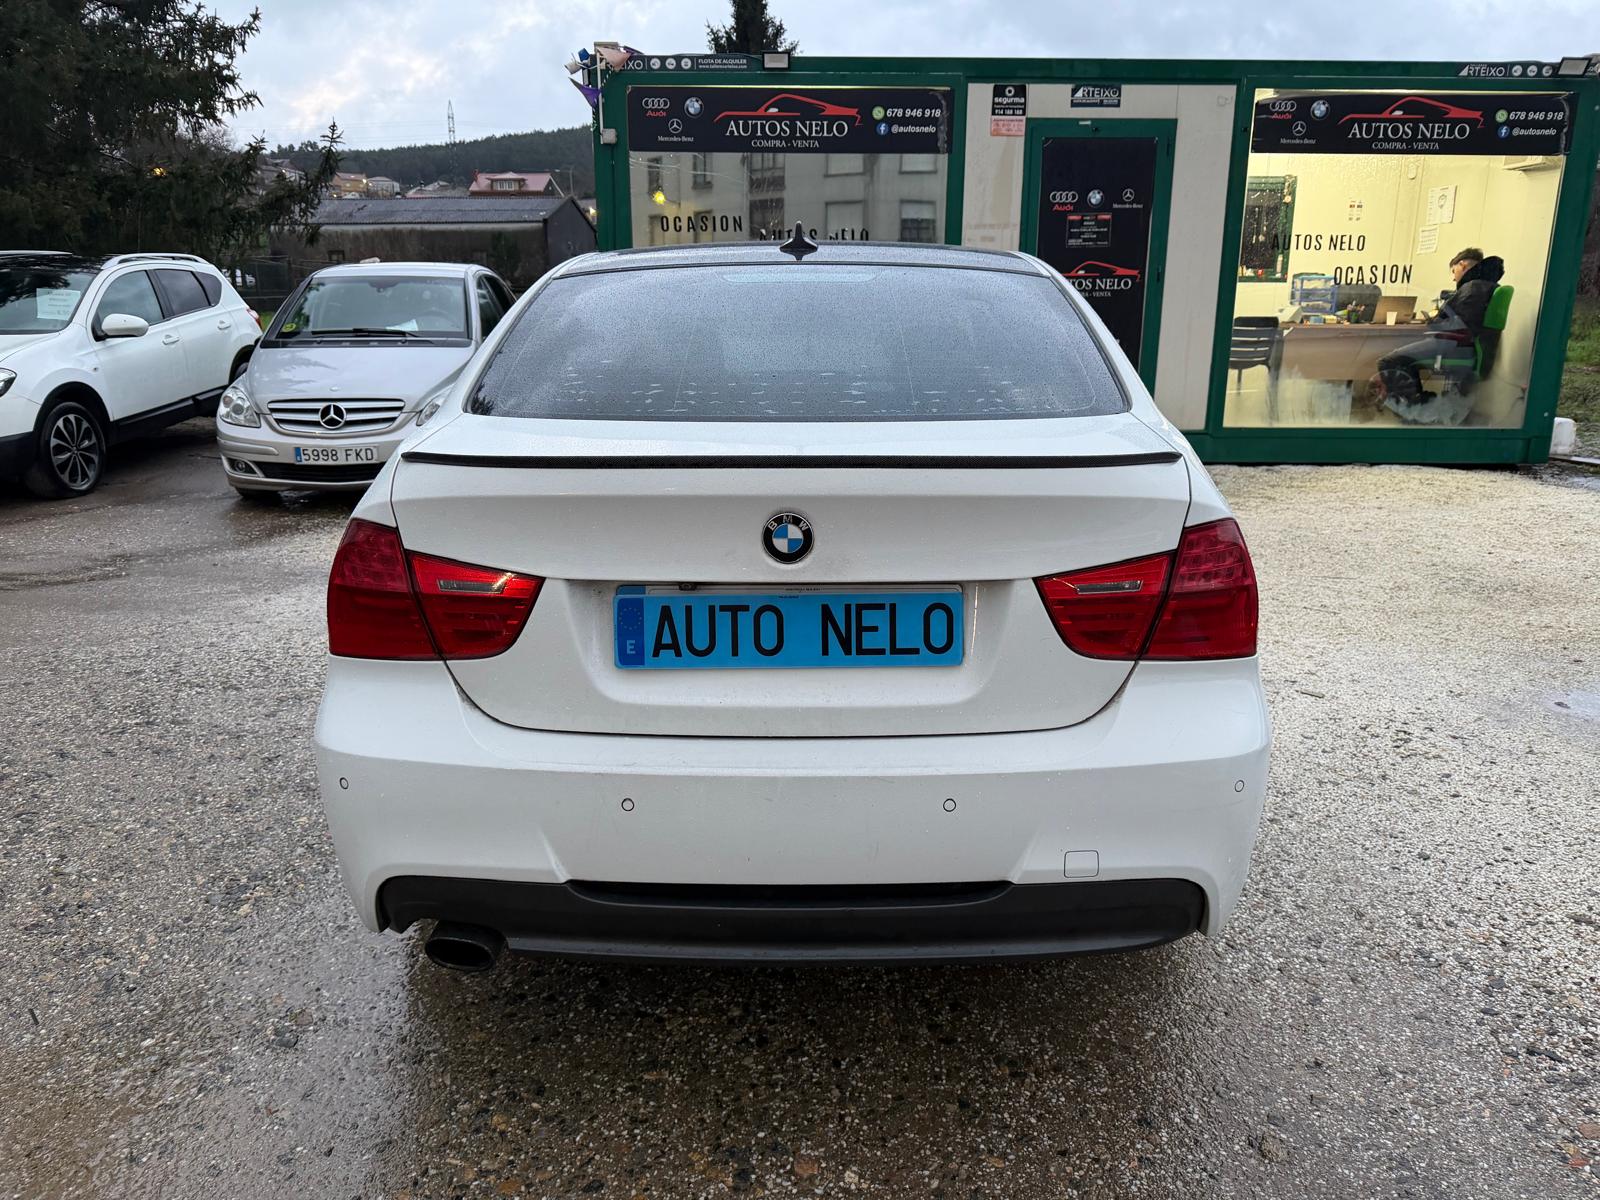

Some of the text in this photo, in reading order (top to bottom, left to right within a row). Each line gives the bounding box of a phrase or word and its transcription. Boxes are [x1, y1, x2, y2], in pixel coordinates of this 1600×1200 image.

[1074, 86, 1119, 98] ARTEIXO
[886, 108, 941, 118] 678 946 918
[1509, 111, 1564, 120] 678 946 918
[725, 119, 848, 137] AUTOS NELO
[891, 124, 937, 134] @autosnelo
[1348, 122, 1470, 140] AUTOS NELO
[1512, 126, 1557, 137] @autosnelo
[751, 140, 787, 148] COMPRA
[792, 140, 820, 148] VENTA
[1372, 141, 1407, 150] COMPRA
[1413, 141, 1440, 150] VENTA
[660, 215, 743, 233] OCASION
[1271, 233, 1366, 251] AUTOS NELO
[1333, 264, 1413, 286] OCASION
[1095, 278, 1132, 290] NELO
[302, 447, 374, 462] 5998 FKD
[768, 514, 809, 531] BMW
[652, 603, 955, 658] AUTO NELO
[626, 639, 636, 655] E
